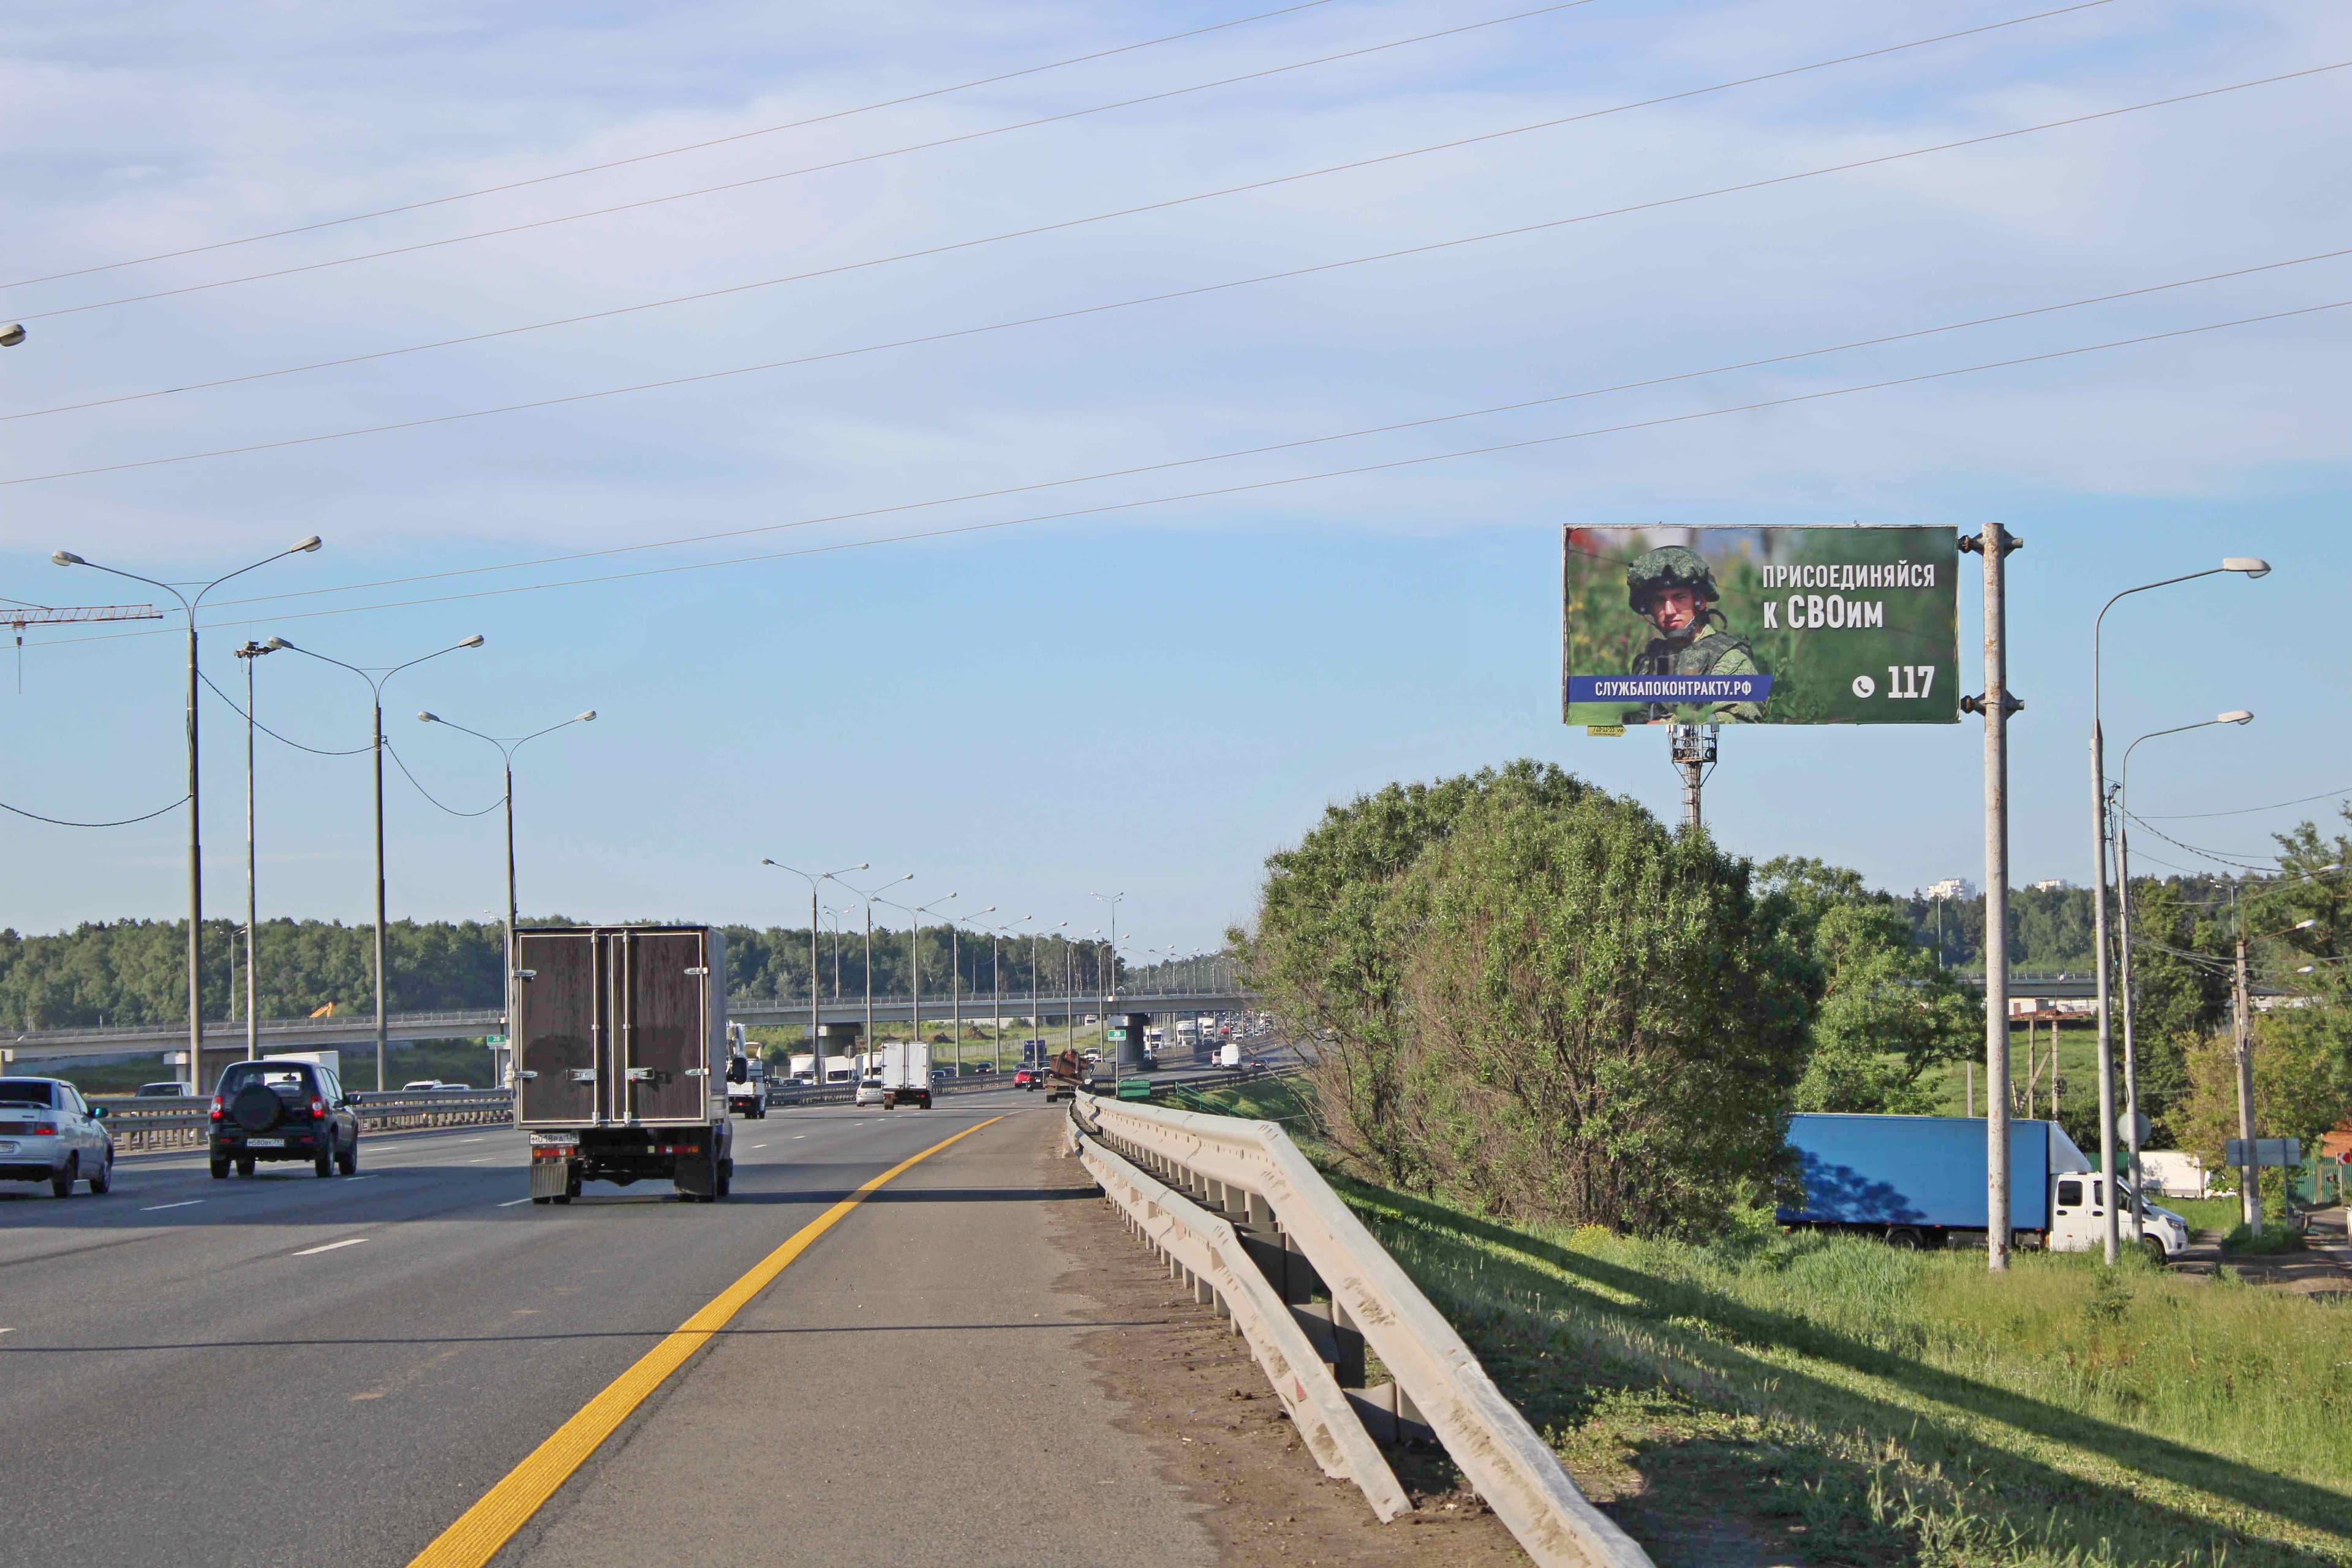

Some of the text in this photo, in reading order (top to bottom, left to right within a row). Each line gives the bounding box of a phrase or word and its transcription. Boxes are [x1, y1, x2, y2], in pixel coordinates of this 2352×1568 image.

[1763, 559, 1935, 590] ПРИСОЕДИНЯЙСЯ
[1595, 680, 1752, 696] СЛУЖБАПОКОНТРАКТУ.РФ
[1888, 666, 1935, 698] 117
